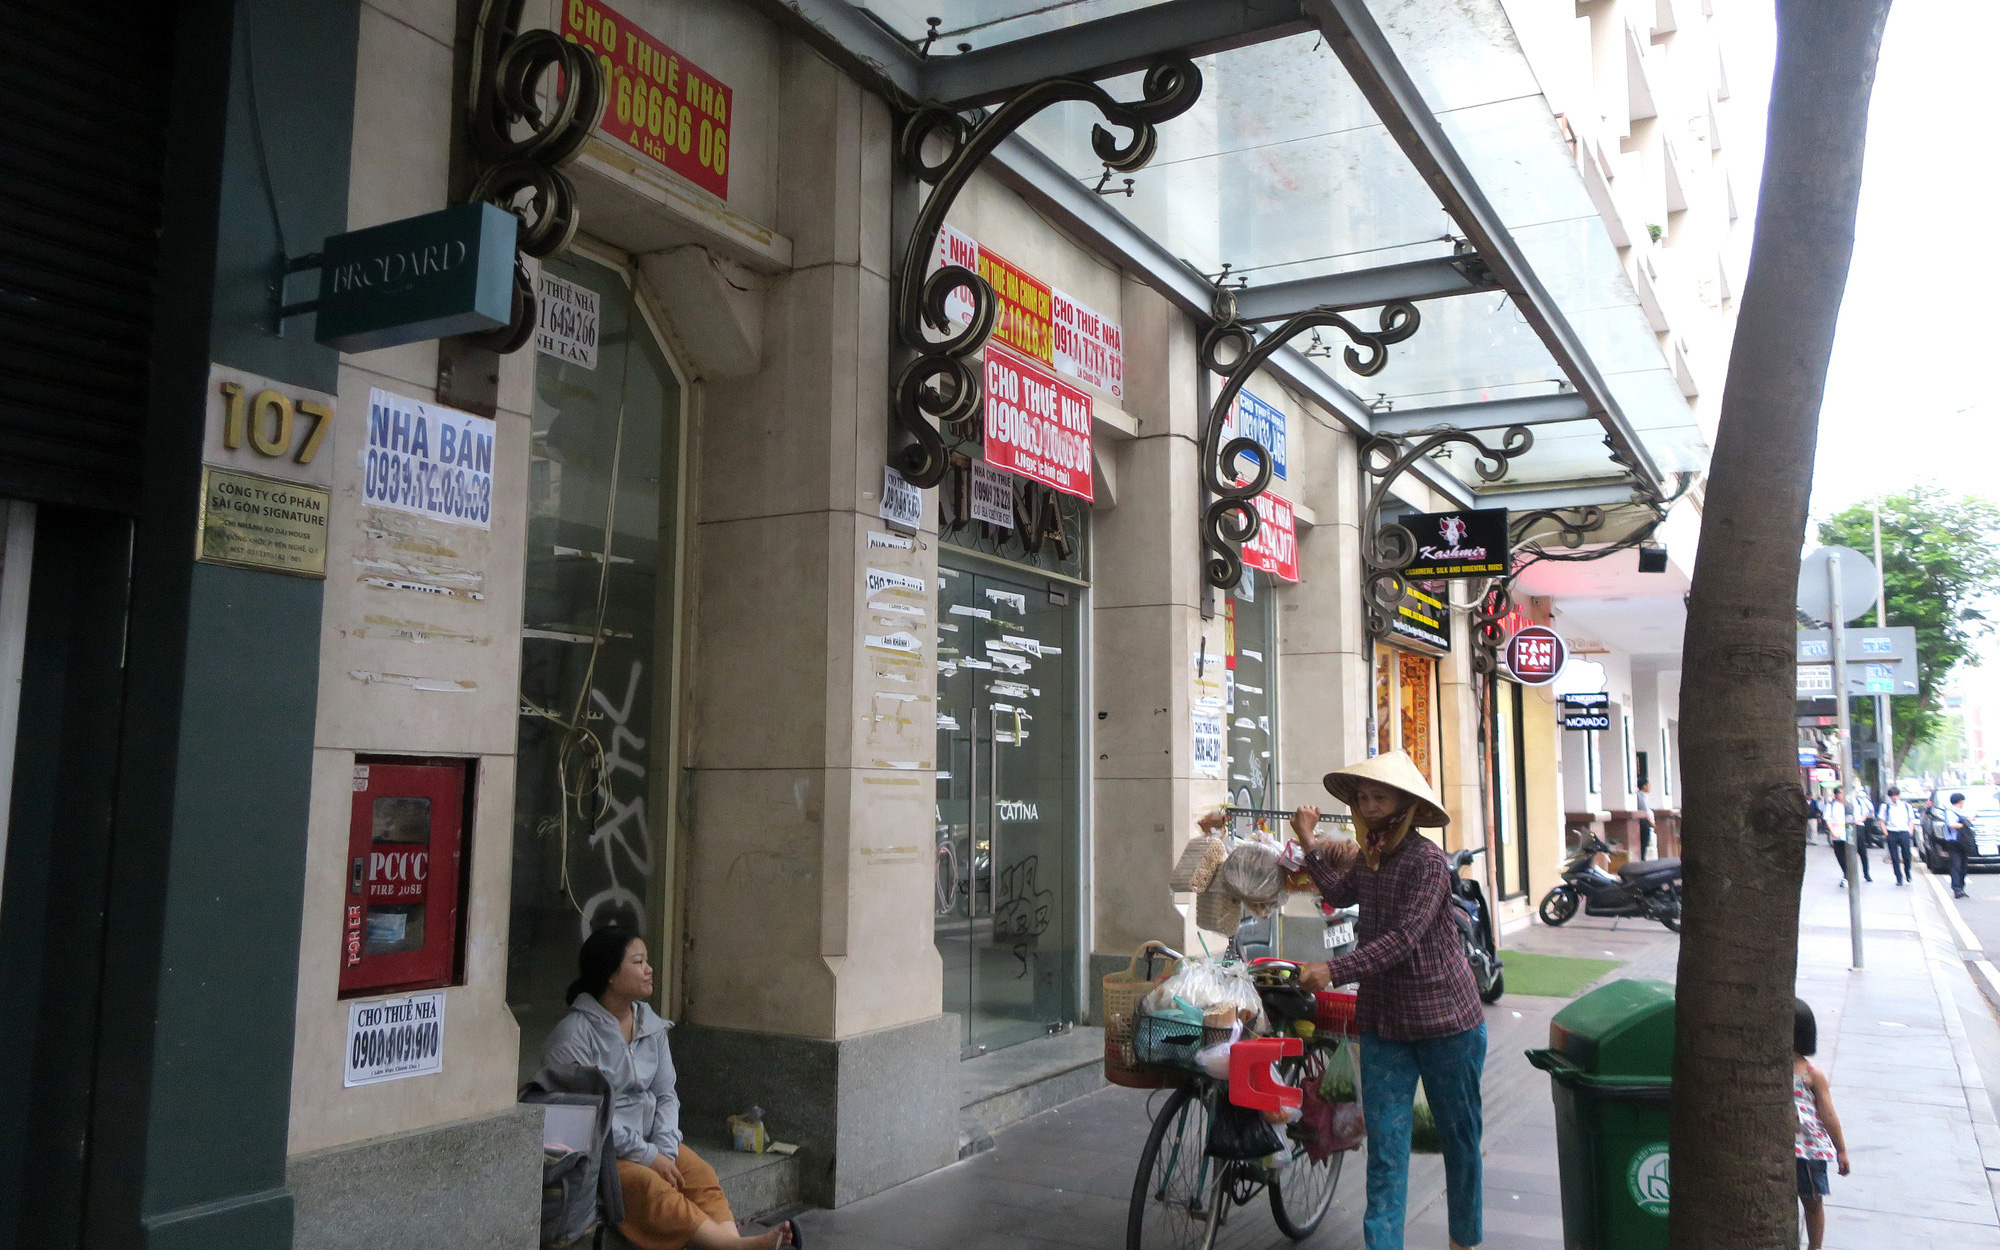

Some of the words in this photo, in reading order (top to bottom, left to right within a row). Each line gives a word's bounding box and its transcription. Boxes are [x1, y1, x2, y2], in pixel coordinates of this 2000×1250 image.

[568, 0, 617, 52] CHO
[625, 31, 679, 94] THUÊ
[686, 72, 726, 124] NHÀ
[630, 130, 640, 147] A
[334, 241, 465, 292] BRODARD
[950, 235, 976, 272] NHÀ
[575, 294, 595, 313] NHÀ
[1054, 296, 1073, 325] CHO
[1075, 314, 1099, 340] THUÊ
[1102, 325, 1120, 352] NHÀ
[988, 360, 1019, 404] CHO
[1022, 384, 1058, 422] THUÊ
[1061, 396, 1090, 436] NHÀ
[220, 382, 333, 464] 107
[370, 404, 429, 459] NHÀ
[440, 420, 492, 474] BÁN
[218, 479, 252, 498] CÔNG
[254, 489, 268, 500] TY
[212, 493, 230, 509] SÀI
[234, 500, 260, 515] GÒN
[263, 506, 324, 526] SIGNATURE
[289, 530, 311, 540] HOUSE
[1419, 545, 1487, 560] Kashmir
[1436, 566, 1449, 574] SILK
[1462, 565, 1487, 573] ORIENTAL
[1566, 717, 1609, 727] MOVADO
[1000, 804, 1038, 821] CATINA
[369, 852, 428, 880] PCCC
[371, 884, 395, 895] FIRE
[358, 1008, 382, 1027] CHO
[384, 999, 413, 1024] THUÊ
[415, 996, 437, 1020] NHÀ
